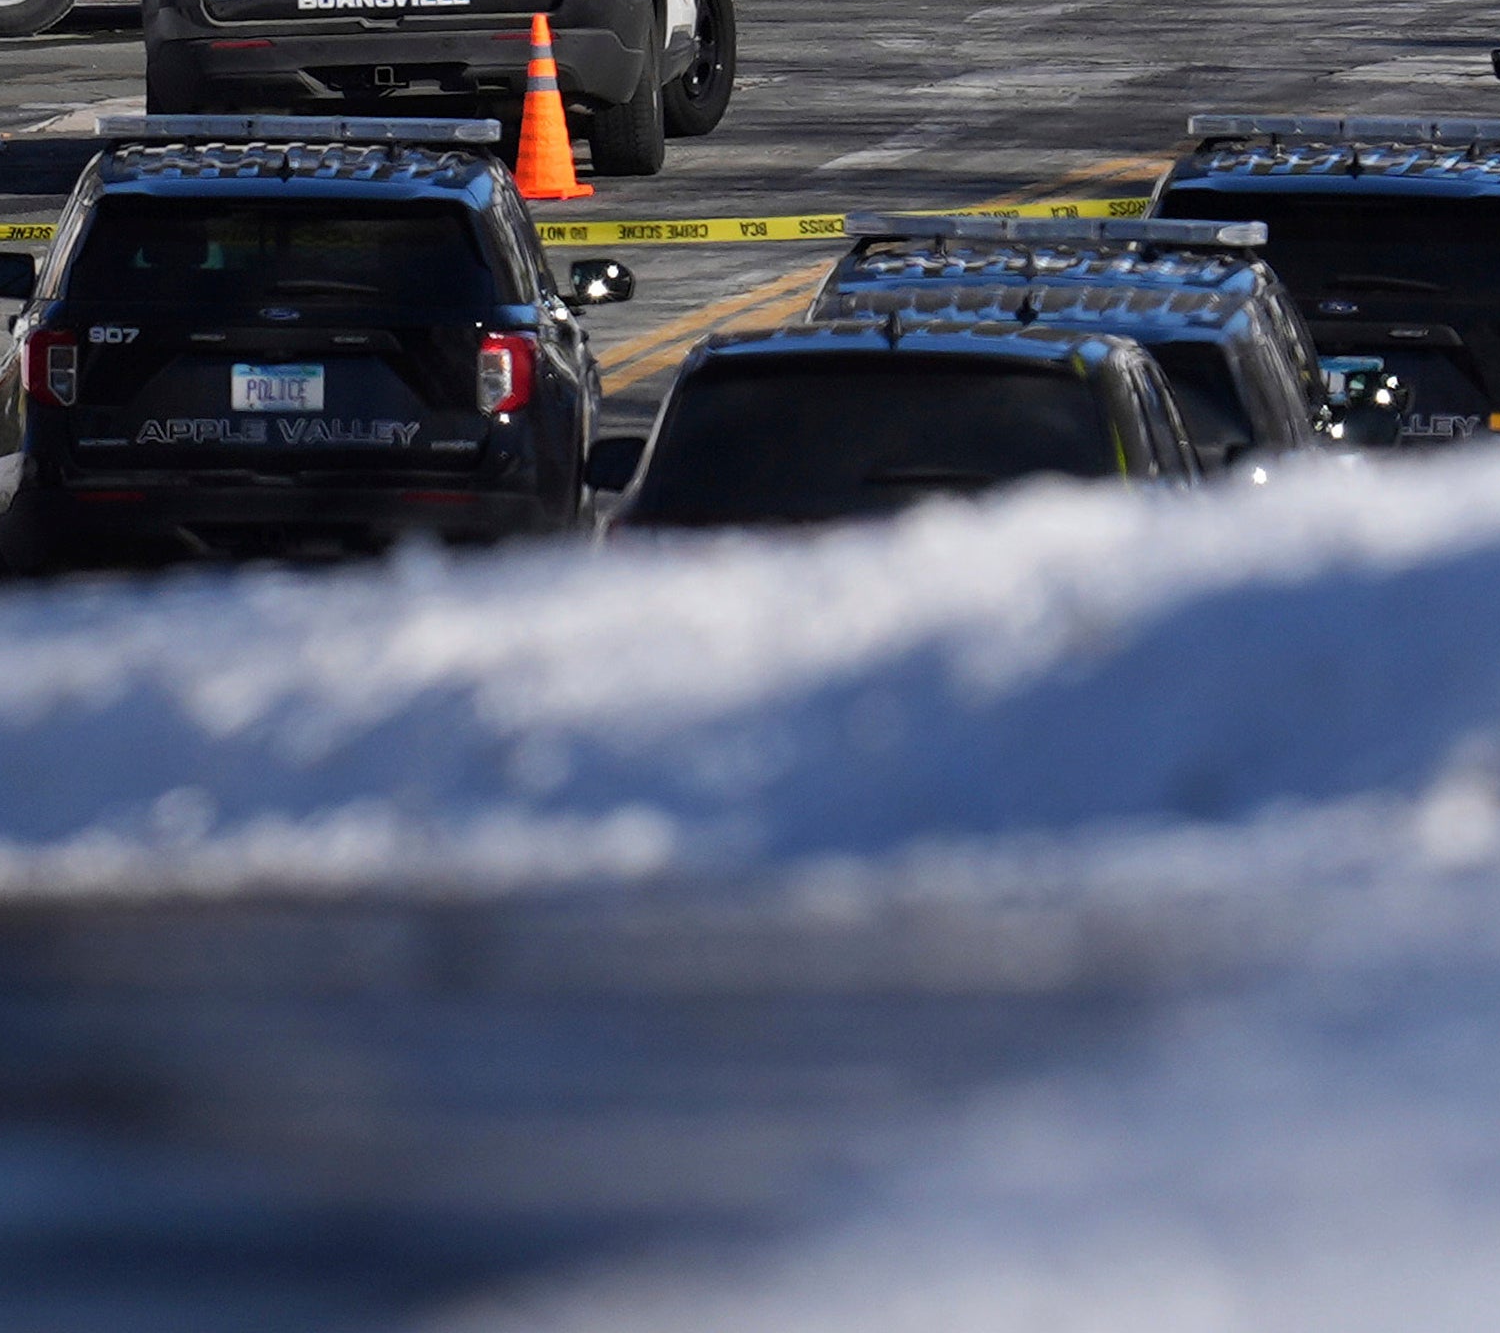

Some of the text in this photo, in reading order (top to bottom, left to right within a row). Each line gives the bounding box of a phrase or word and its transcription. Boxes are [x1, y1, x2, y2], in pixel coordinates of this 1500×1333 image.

[1109, 200, 1148, 217] ROSS
[6, 226, 54, 240] SCENE
[570, 226, 589, 241] DO
[617, 225, 663, 240] SCENE
[665, 224, 709, 239] CRIME
[739, 221, 768, 237] BCA
[799, 218, 845, 234] CROSS
[88, 326, 140, 344] 907
[246, 378, 308, 403] POLICE
[135, 418, 421, 447] APPLE VALLEY
